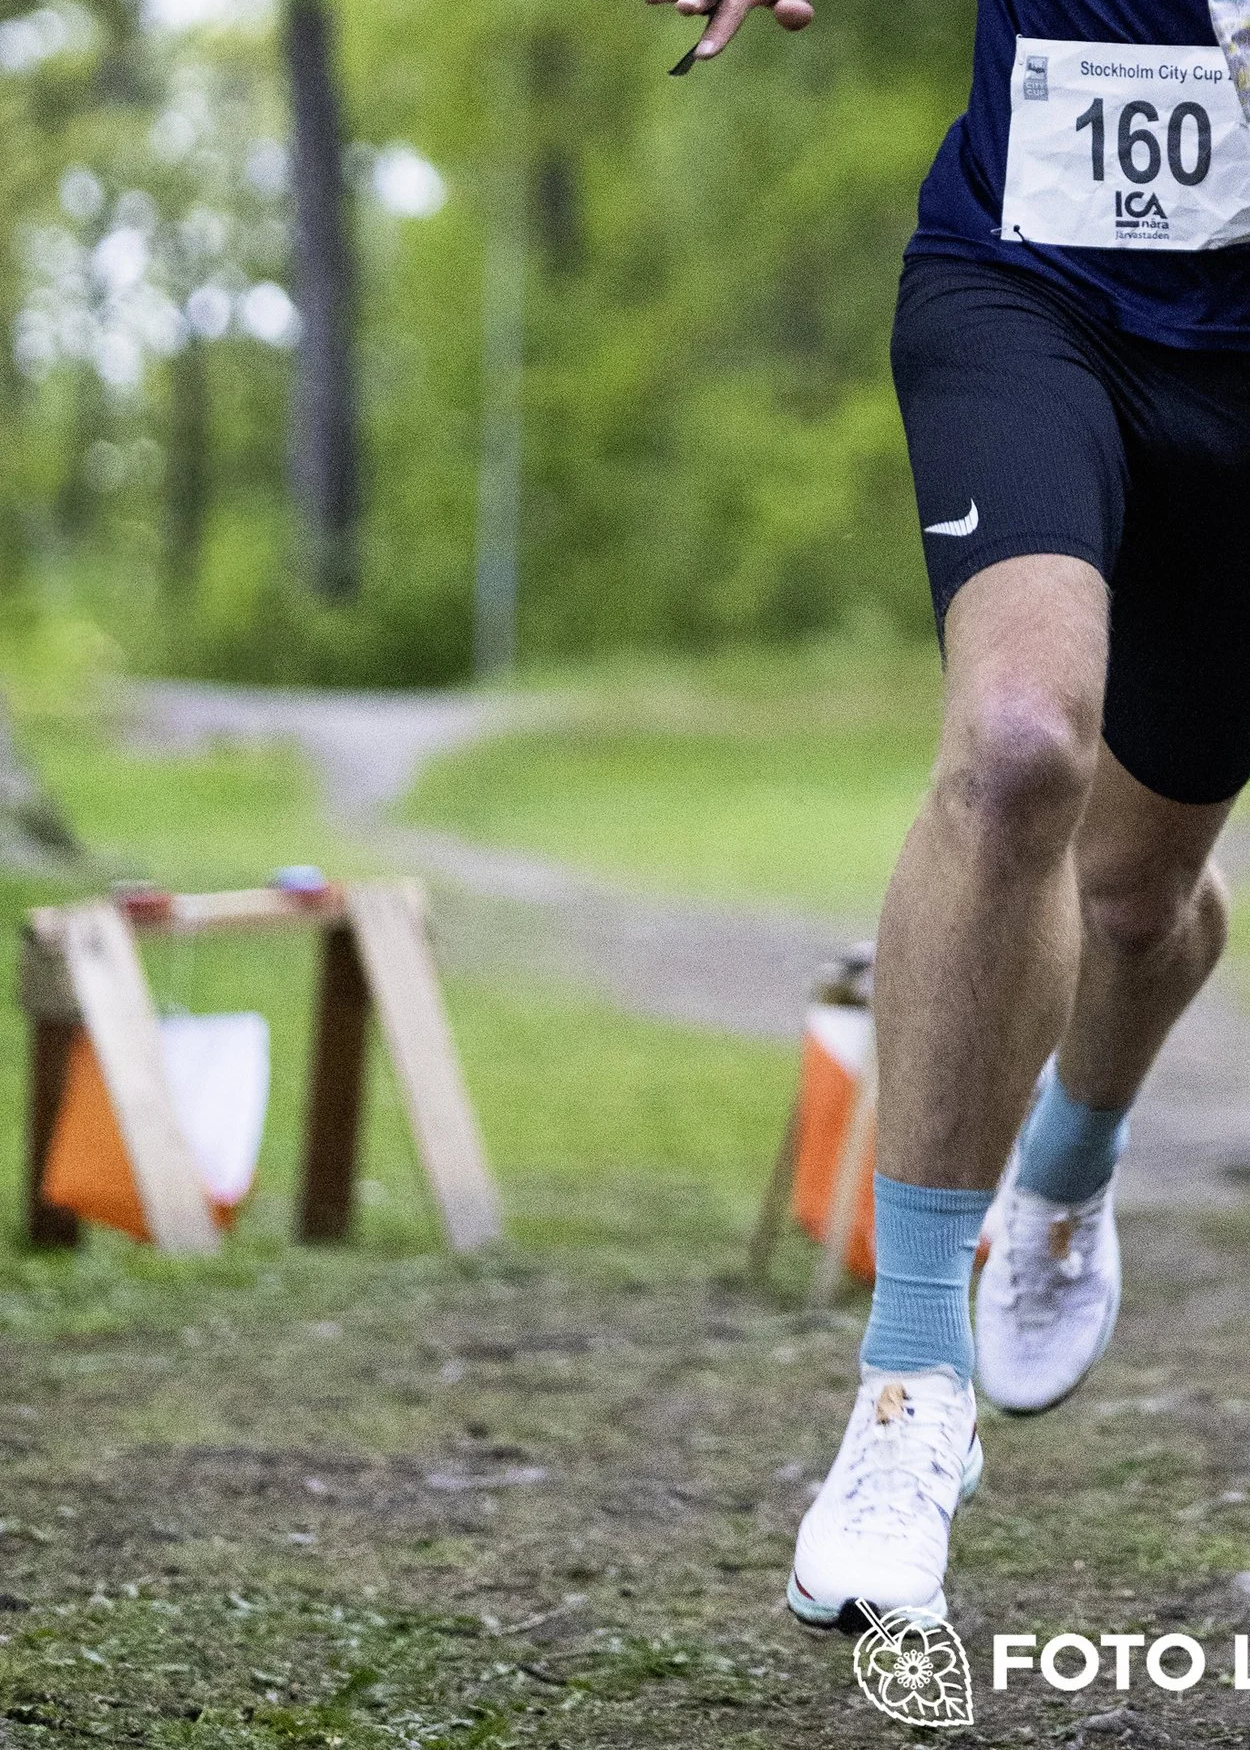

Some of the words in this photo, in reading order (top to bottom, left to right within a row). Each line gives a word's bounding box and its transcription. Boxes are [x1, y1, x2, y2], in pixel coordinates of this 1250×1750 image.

[1080, 61, 1153, 80] Stockholm
[1158, 65, 1187, 83] City
[1192, 65, 1223, 81] Cup
[1075, 97, 1212, 186] 160
[1115, 190, 1168, 219] ICA
